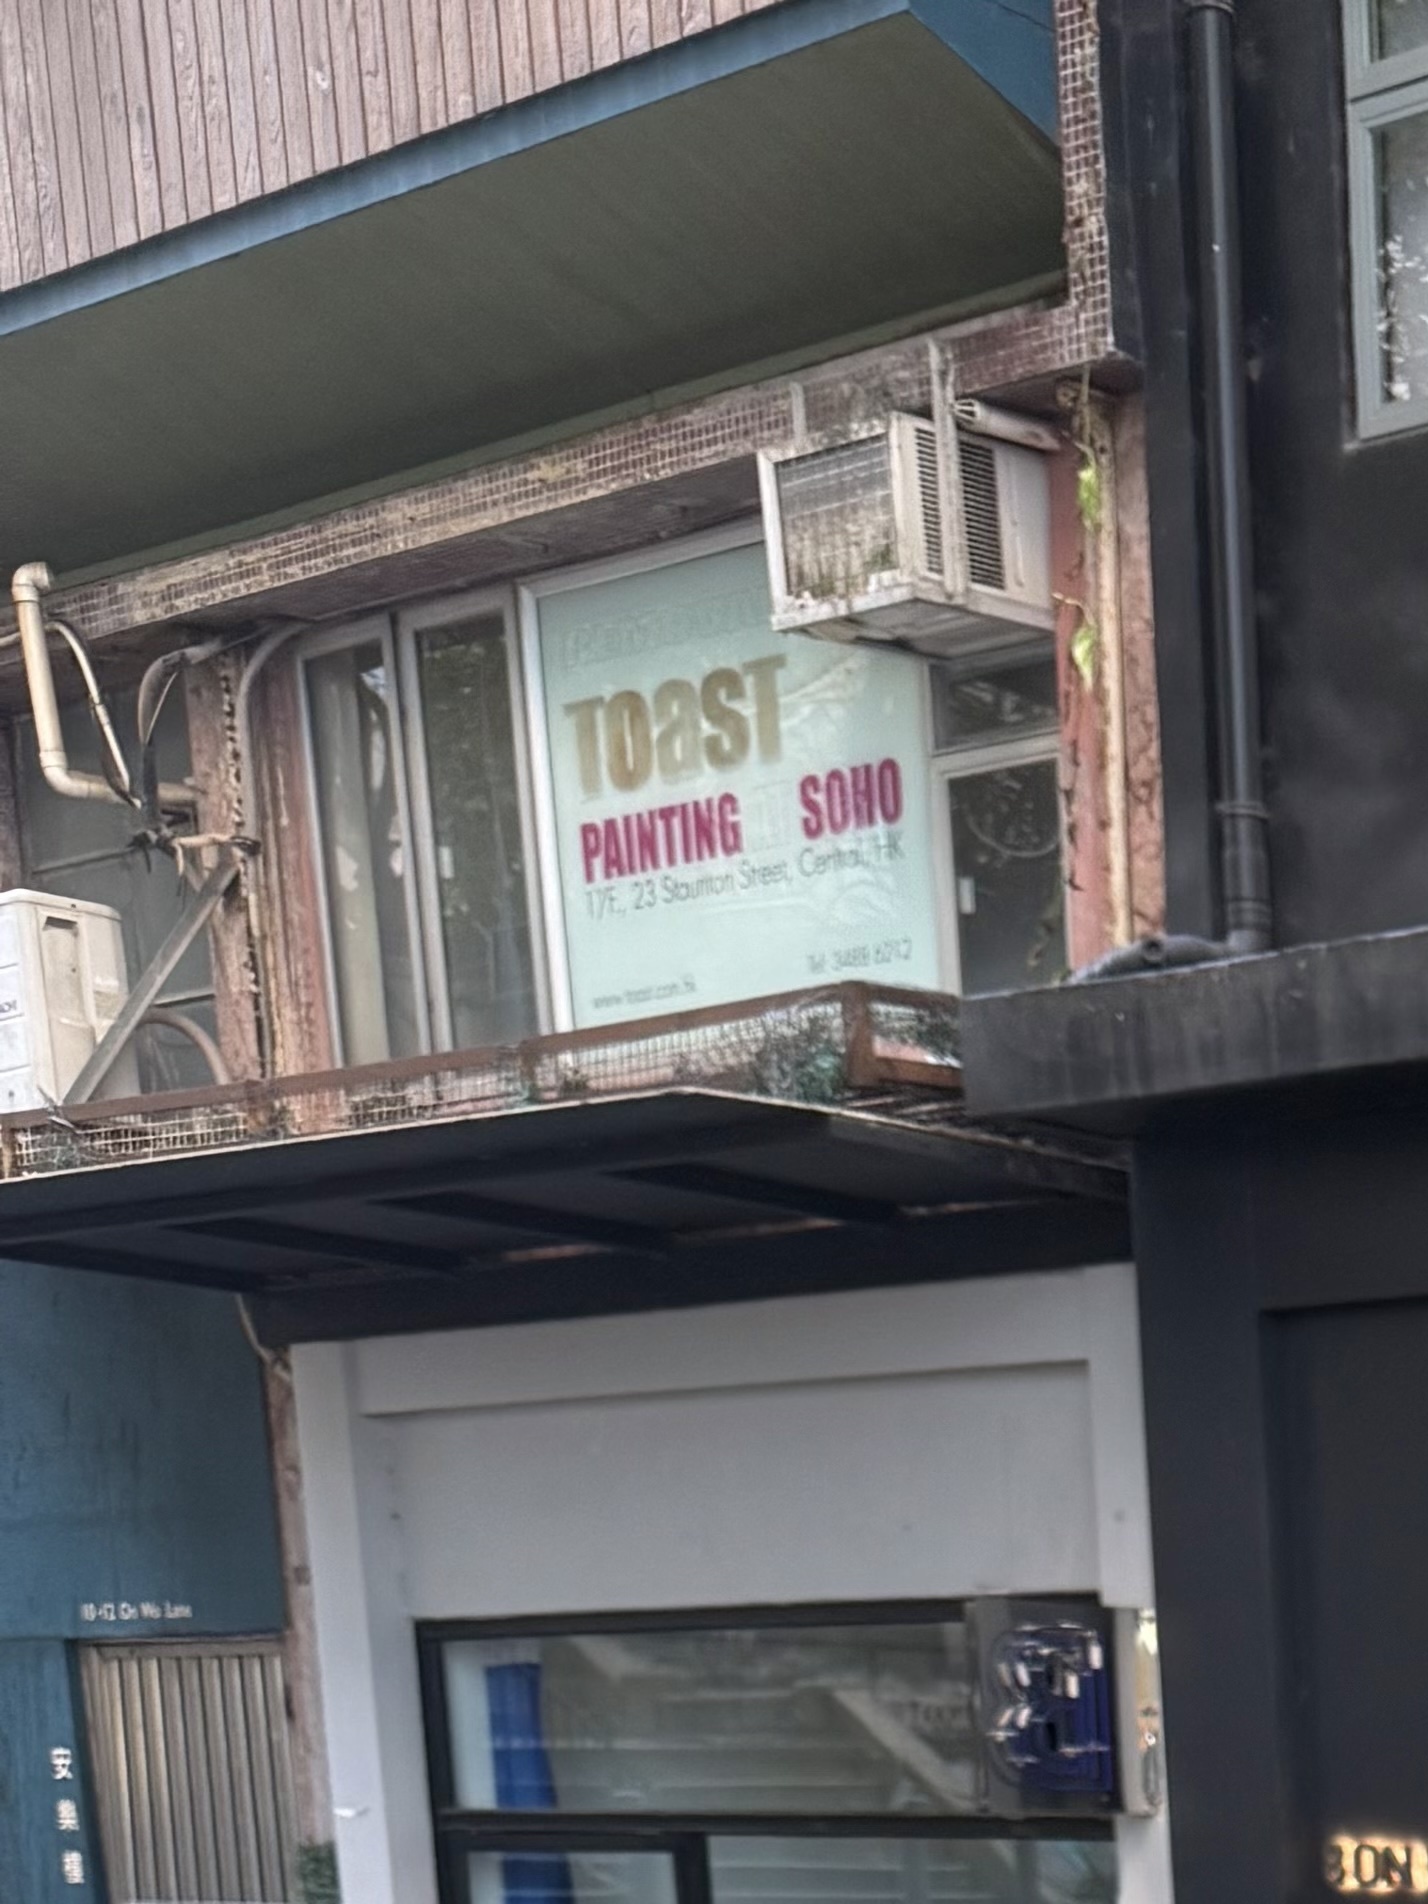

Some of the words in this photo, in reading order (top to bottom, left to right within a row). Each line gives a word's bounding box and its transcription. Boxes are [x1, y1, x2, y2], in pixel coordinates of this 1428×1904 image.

[579, 792, 744, 884] PAINTING
[798, 757, 904, 840] SOHO
[1353, 1842, 1415, 1890] ON
